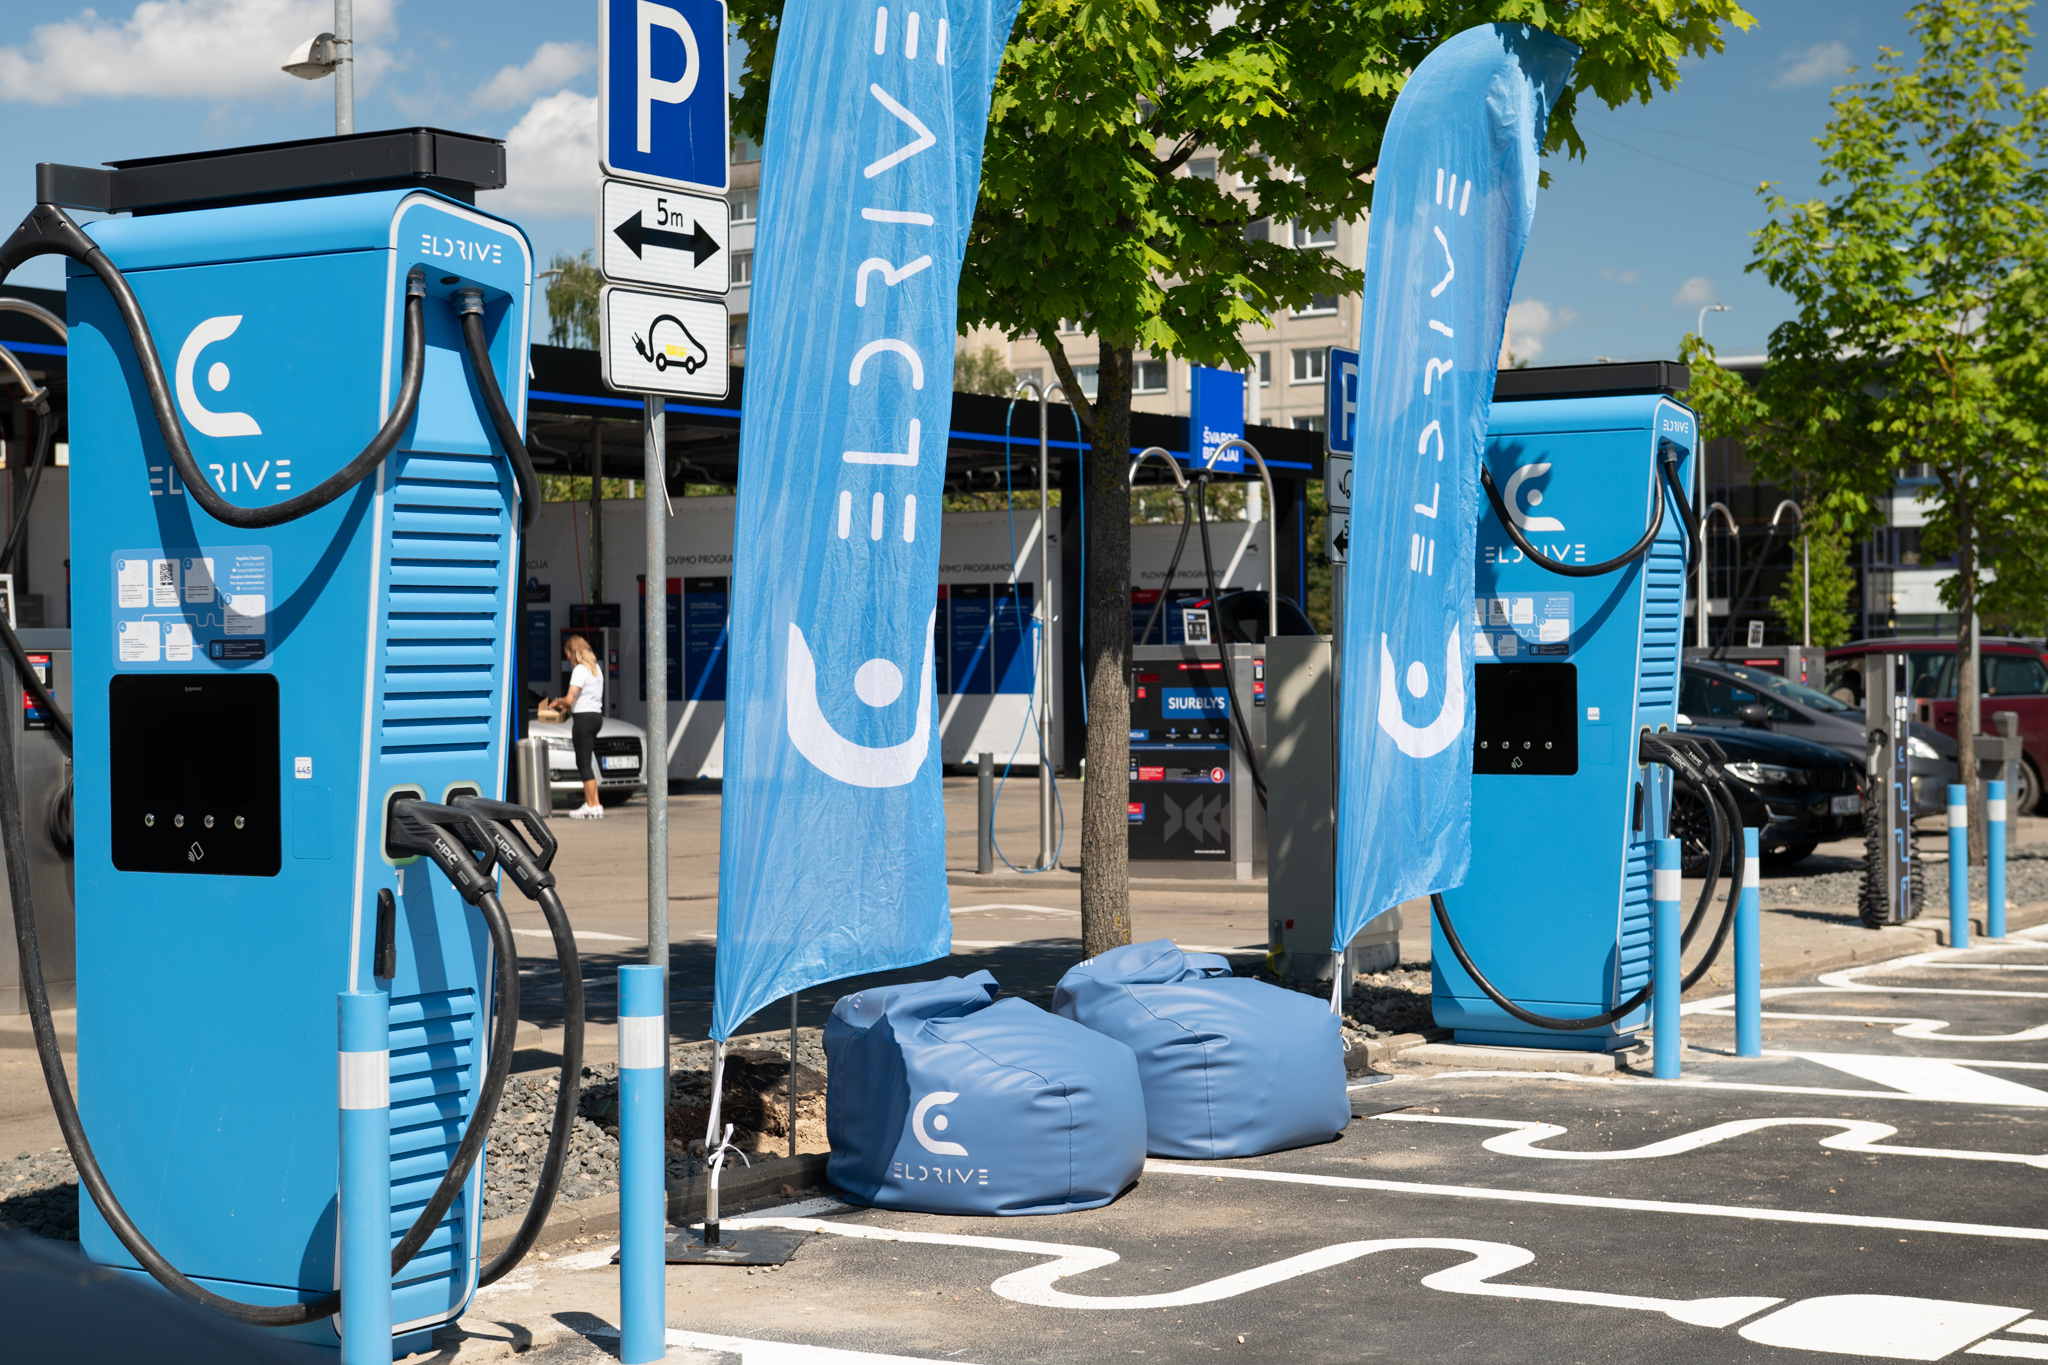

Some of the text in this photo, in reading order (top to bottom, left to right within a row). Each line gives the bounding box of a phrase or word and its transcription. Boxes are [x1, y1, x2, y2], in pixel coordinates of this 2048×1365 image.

[637, 0, 700, 154] P
[657, 198, 684, 228] 5m
[421, 234, 502, 264] ELDRIVE
[838, 6, 947, 543] ELDRIVE
[1411, 168, 1471, 576] ELDRIVE
[1663, 419, 1688, 433] ELDRIVE
[150, 460, 291, 496] ELRIVE
[526, 560, 548, 569] KCIJA
[666, 554, 733, 565] OVIMO PROGRA
[1485, 544, 1586, 563] ELDIVE
[1168, 697, 1225, 710] SIURBLYS
[1214, 770, 1221, 780] 4
[434, 838, 459, 866] HPC
[394, 869, 404, 896] 1
[894, 1162, 988, 1185] ELDRIVE
